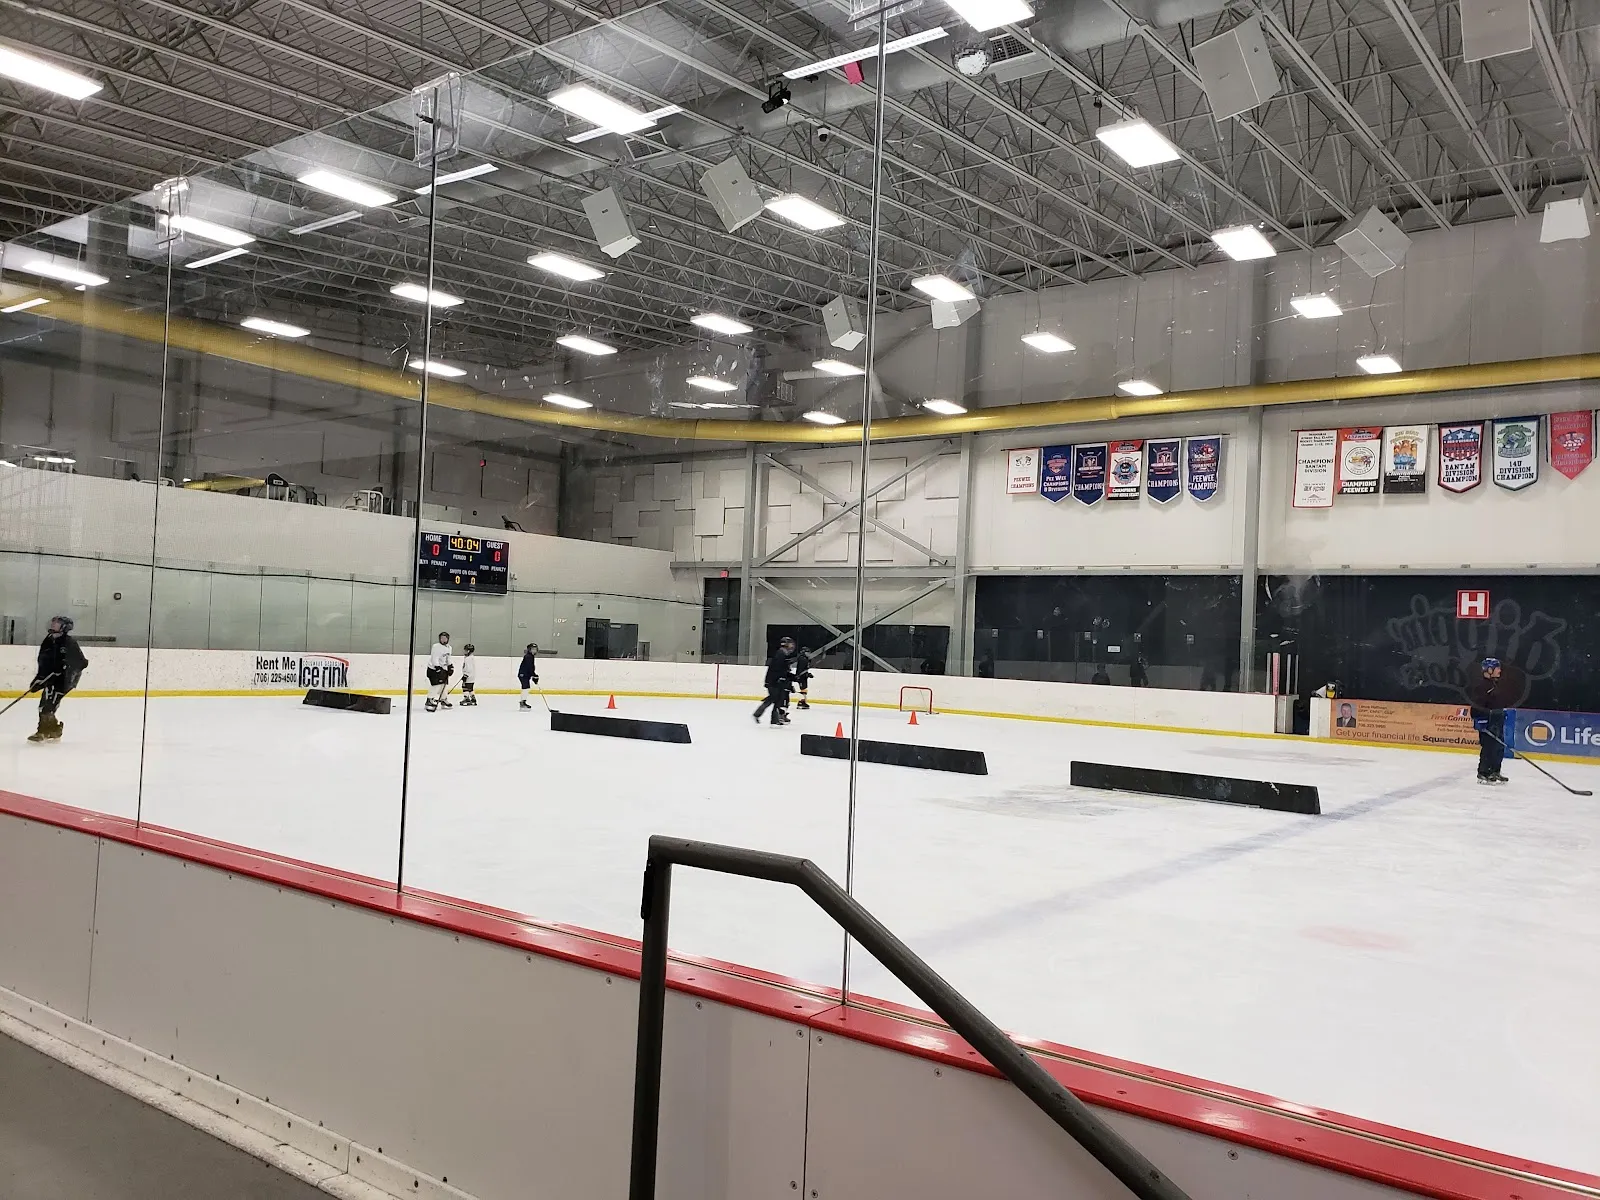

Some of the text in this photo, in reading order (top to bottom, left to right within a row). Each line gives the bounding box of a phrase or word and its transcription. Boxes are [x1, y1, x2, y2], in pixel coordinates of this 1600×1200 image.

[1192, 474, 1215, 482] PEEWEE
[425, 534, 442, 542] HOME
[451, 538, 479, 550] 40:04
[432, 544, 440, 556] 0
[486, 541, 504, 549] GUEST
[455, 576, 461, 584] 0
[1461, 593, 1486, 616] H
[256, 656, 296, 670] Rent Me
[254, 672, 269, 685] (706)
[1336, 728, 1351, 737] Get
[1352, 731, 1370, 739] your
[1372, 731, 1406, 740] financial
[1407, 733, 1420, 741] life
[1560, 726, 1600, 746] Life
